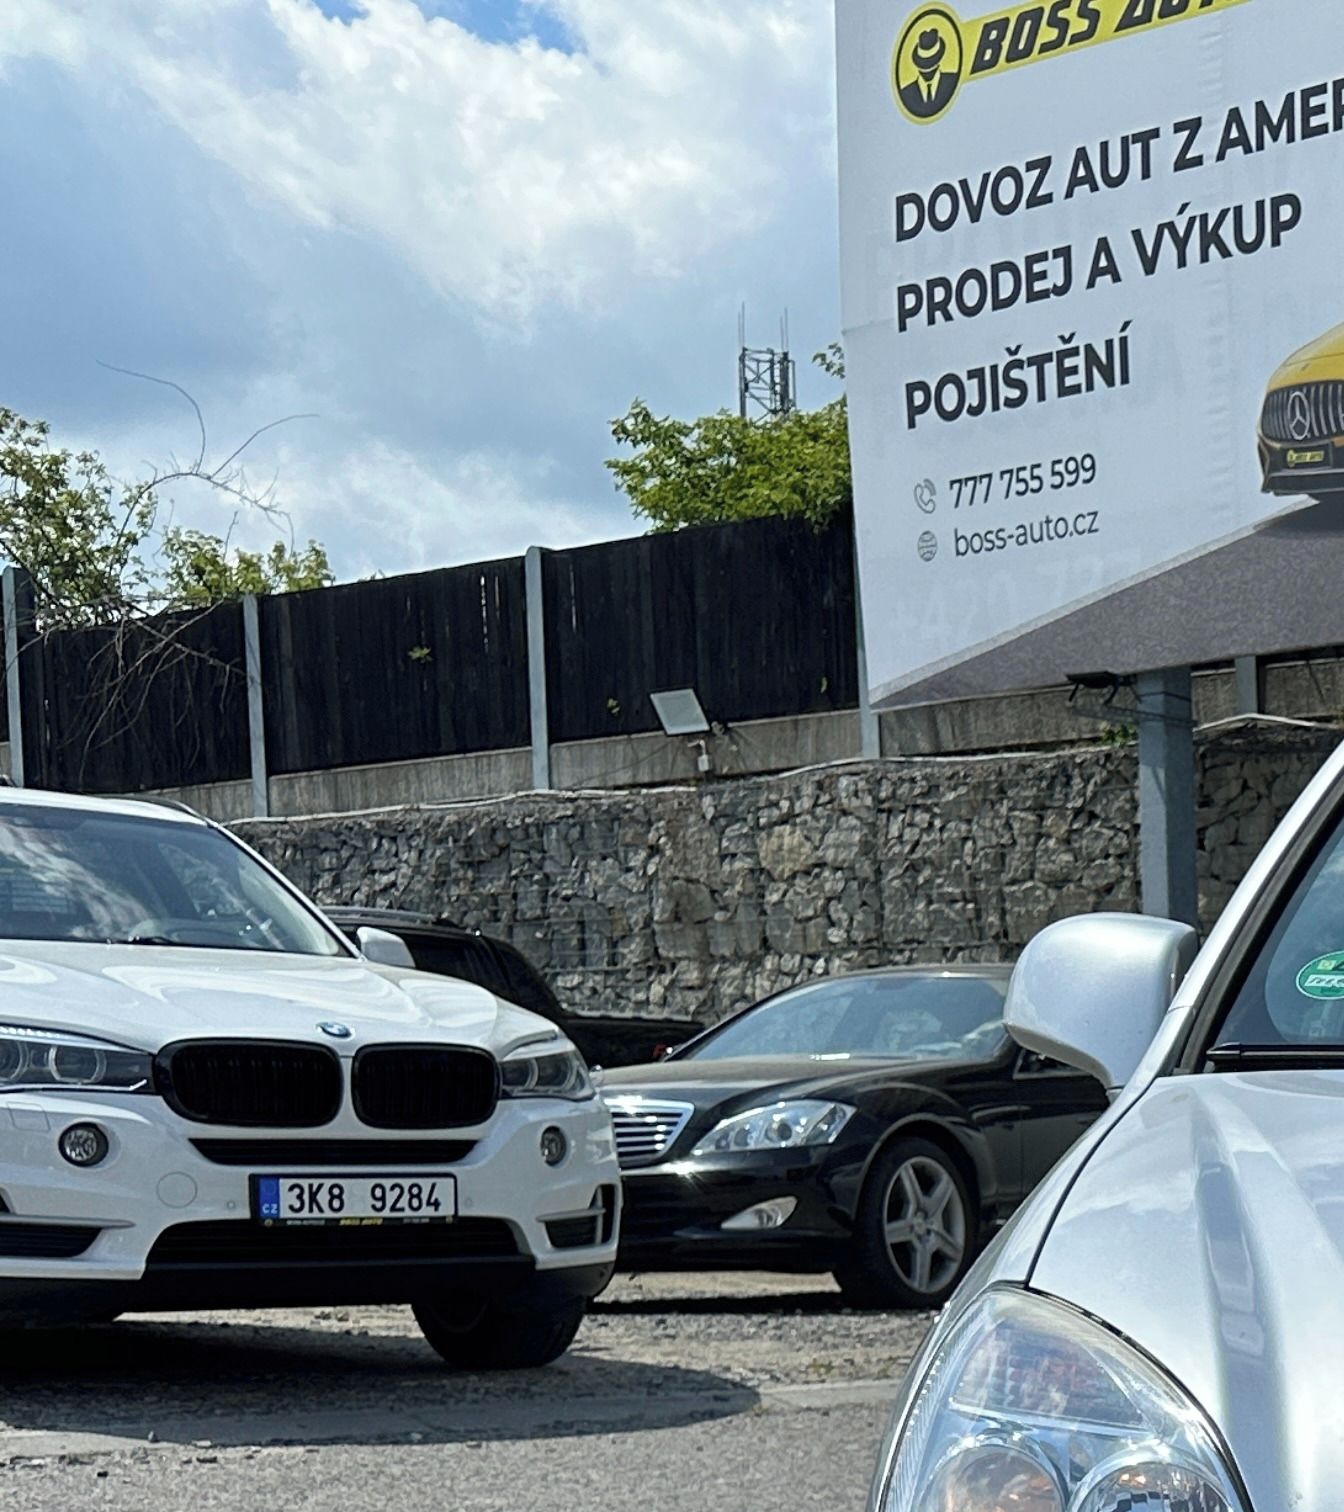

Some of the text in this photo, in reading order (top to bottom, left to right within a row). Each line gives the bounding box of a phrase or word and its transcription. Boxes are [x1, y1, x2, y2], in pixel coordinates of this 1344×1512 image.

[970, 0, 1101, 75] BOSS
[896, 156, 1053, 242] DOVOZ
[1065, 127, 1160, 200] AUT
[1173, 116, 1204, 173] Z
[897, 193, 1302, 332] PRODEJ A VÝKUP
[905, 319, 1133, 430] POJIŠTĚNÍ
[949, 453, 1097, 509] 777 755 599
[953, 510, 1100, 557] boss-auto.cz
[262, 1203, 278, 1214] CZ
[287, 1182, 442, 1214] 3K8 9284
